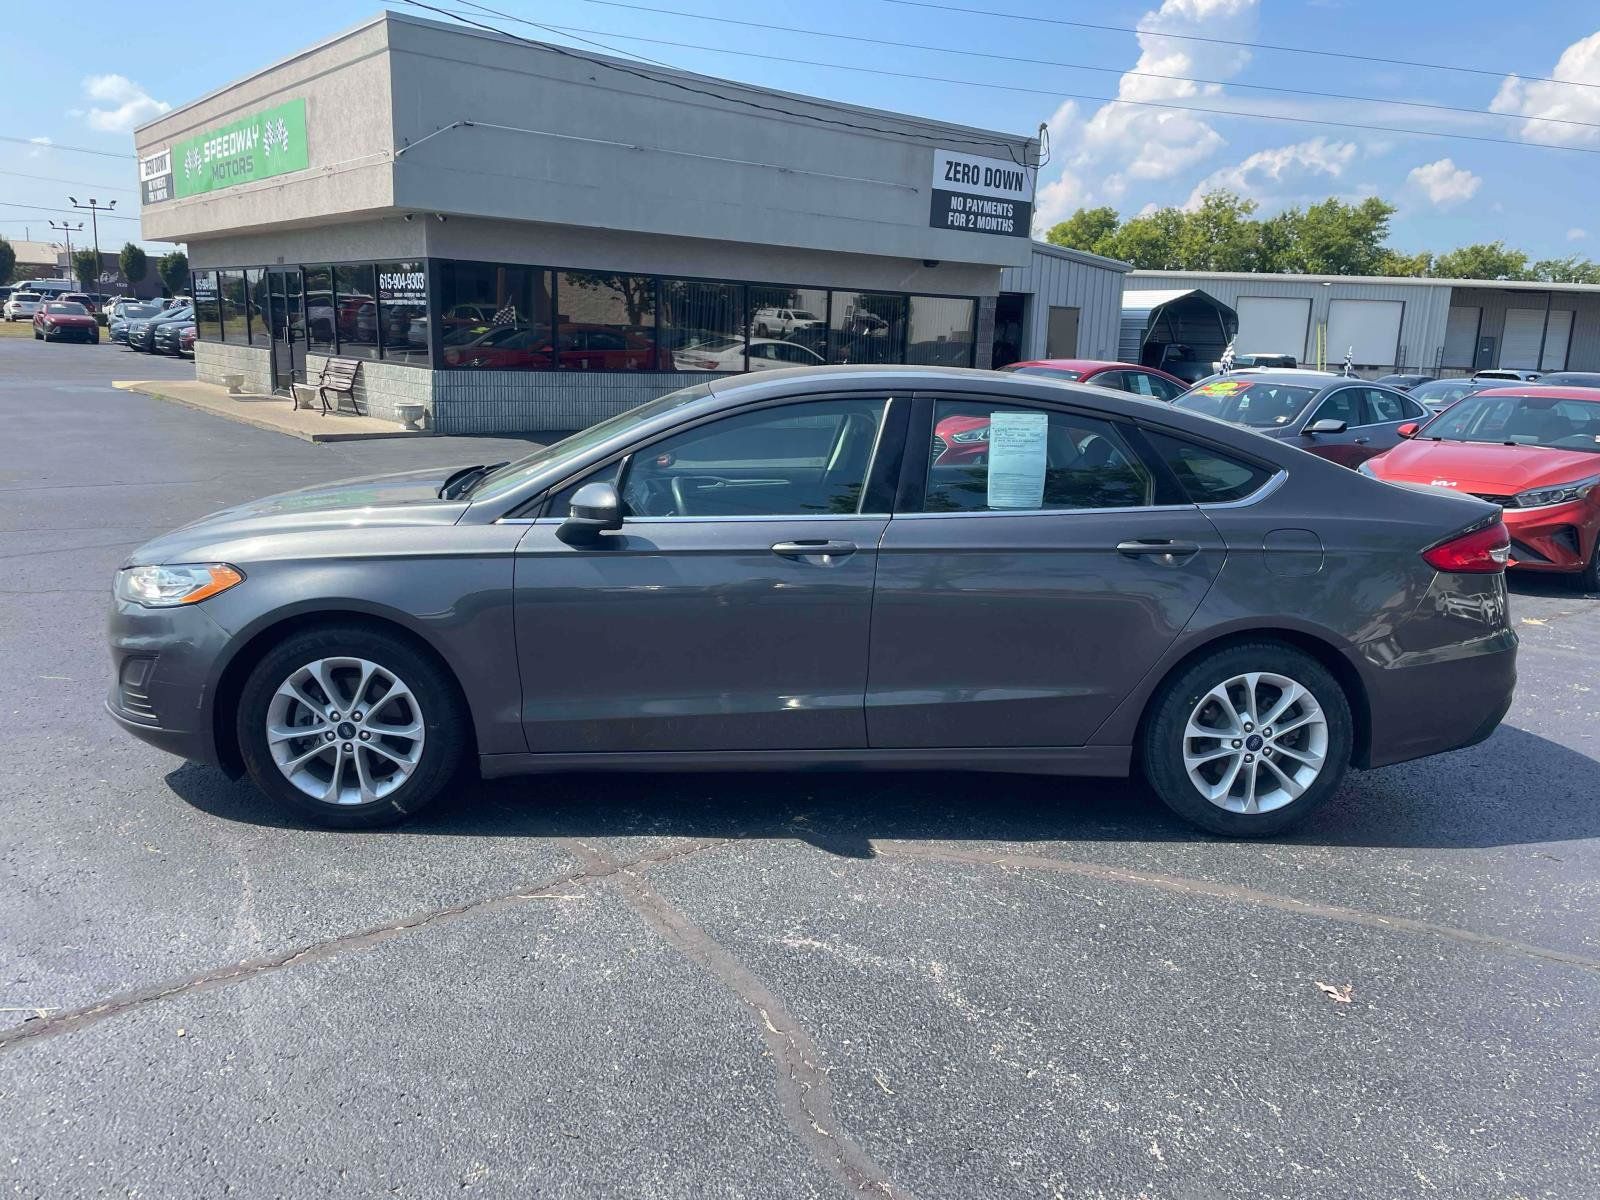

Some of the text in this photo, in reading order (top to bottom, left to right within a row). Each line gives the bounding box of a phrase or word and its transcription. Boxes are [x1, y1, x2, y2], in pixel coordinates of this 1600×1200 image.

[203, 124, 259, 163] SPEEDWAY
[211, 155, 255, 181] MOTORS
[944, 160, 1024, 192] ZERO DOWN
[950, 196, 1014, 217] NO PAYMENTS
[947, 211, 1014, 233] FOR 2 MONTHS
[379, 272, 424, 290] 615-904-9303
